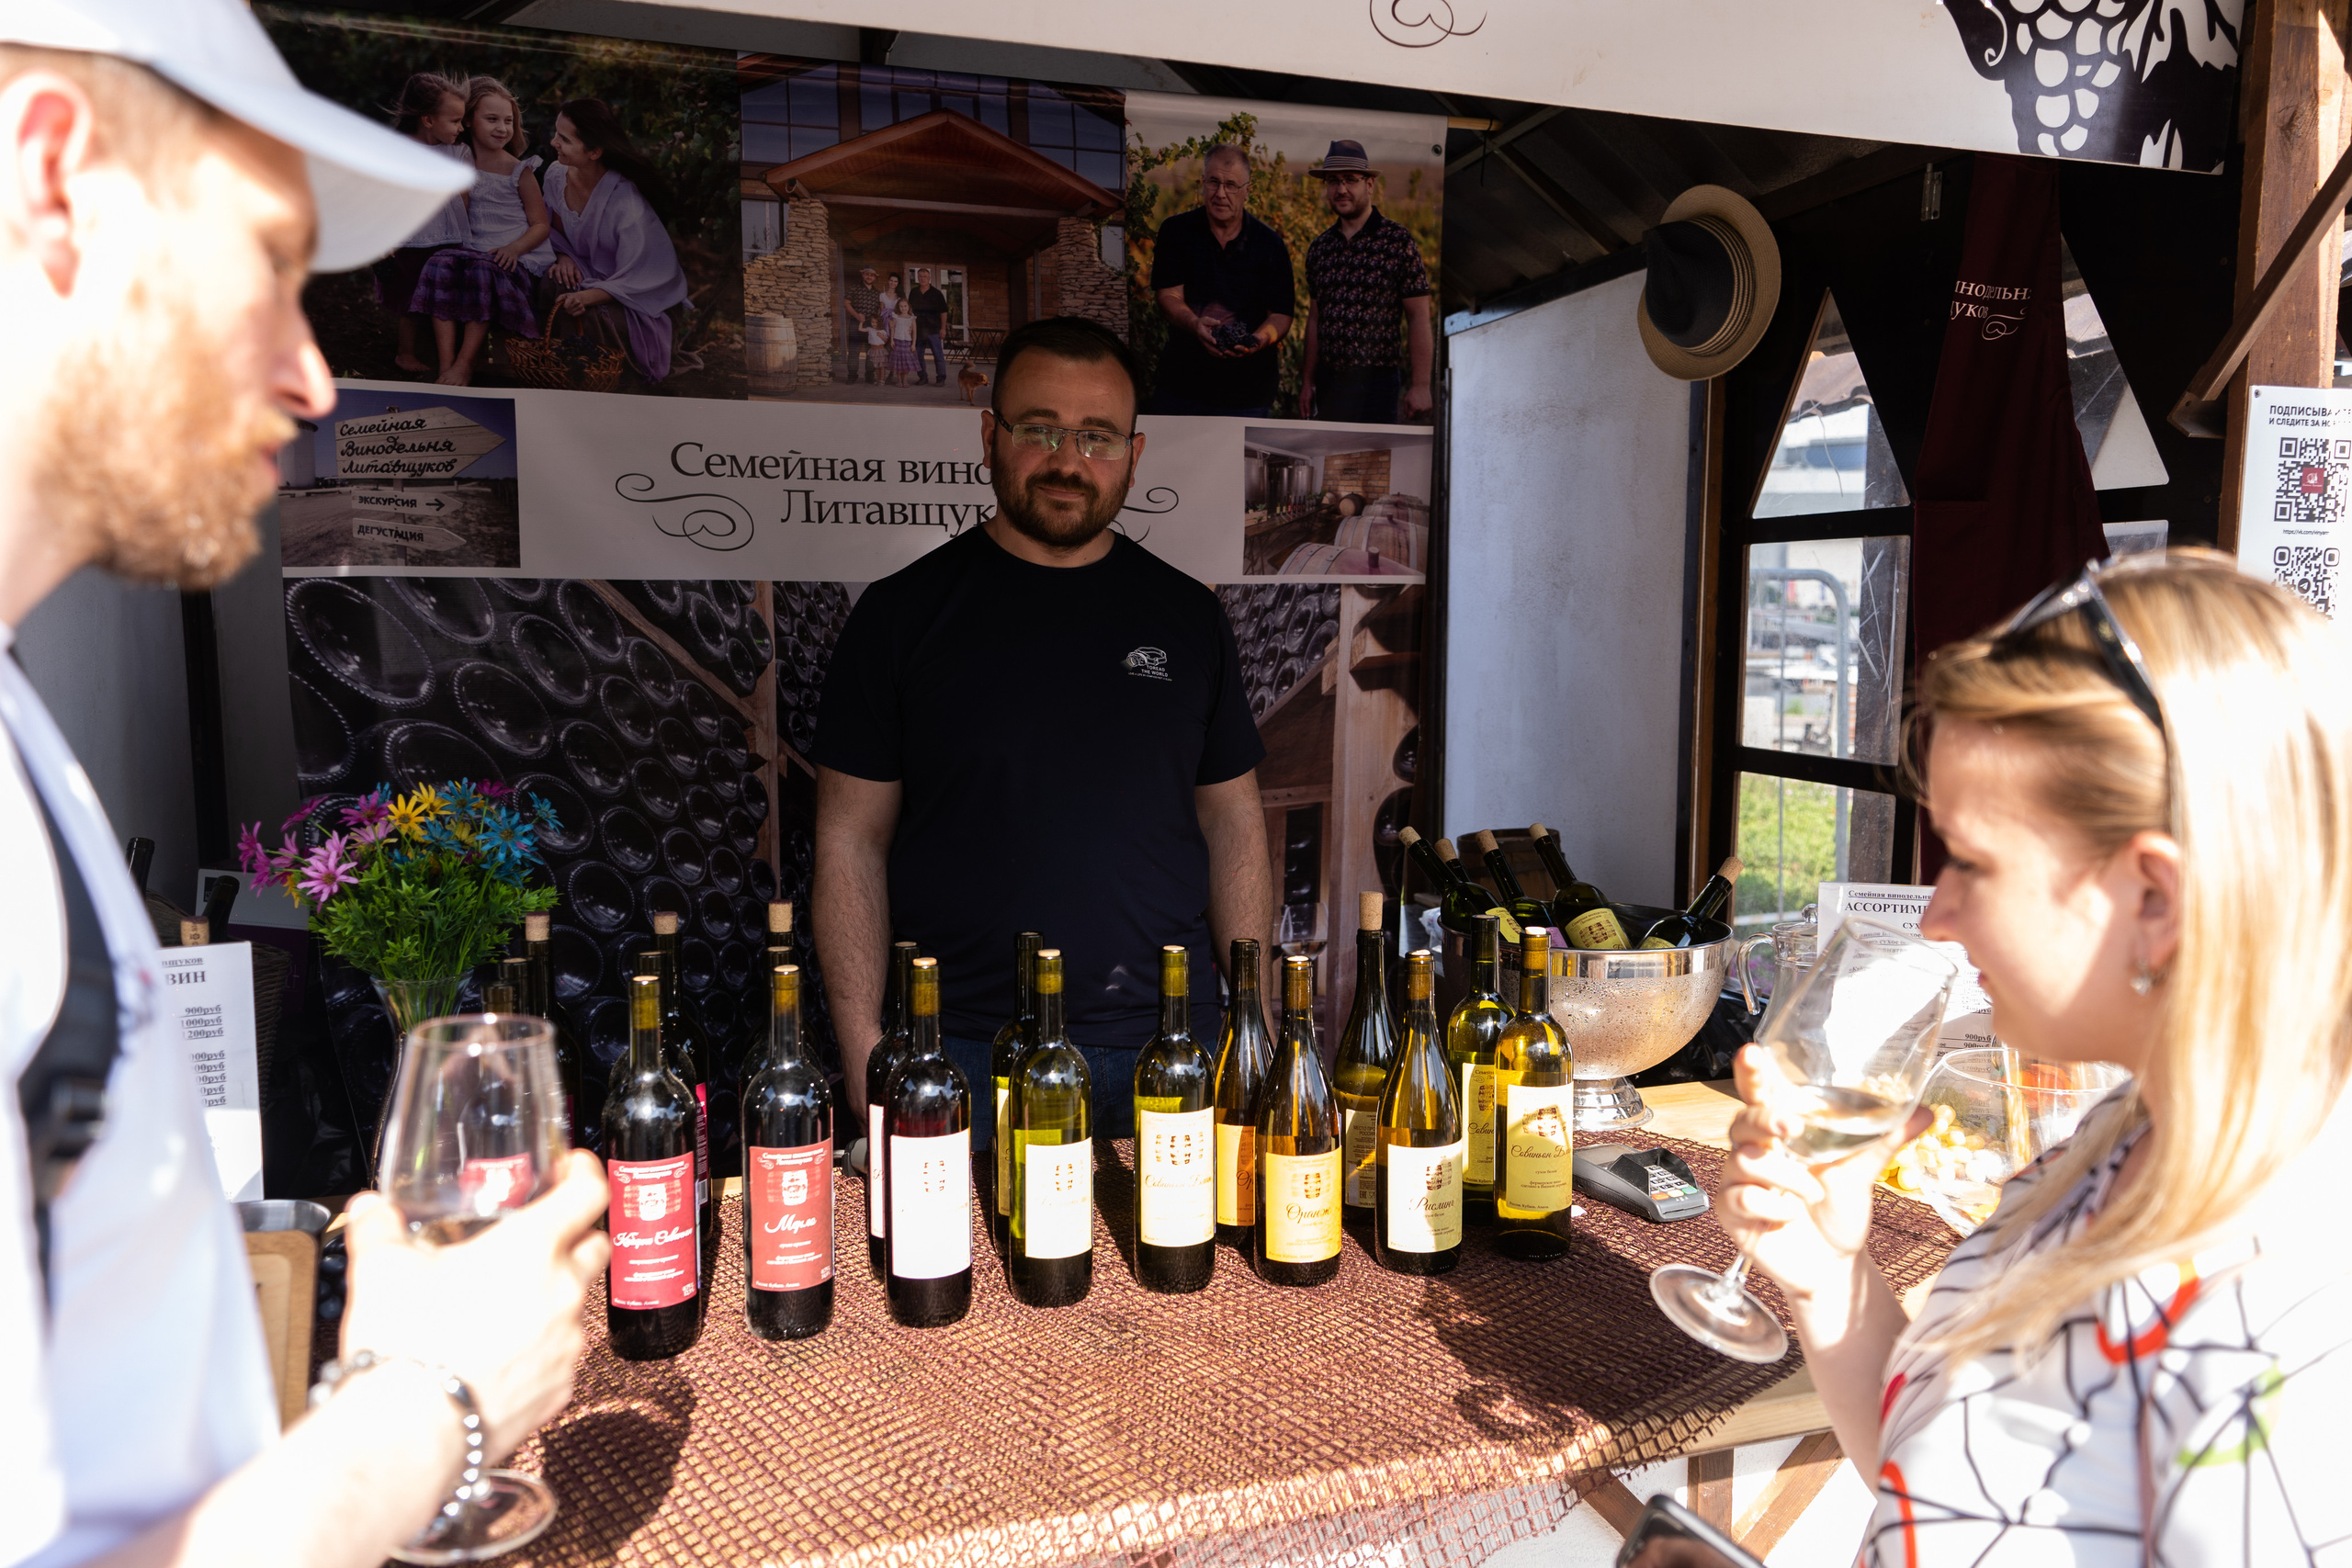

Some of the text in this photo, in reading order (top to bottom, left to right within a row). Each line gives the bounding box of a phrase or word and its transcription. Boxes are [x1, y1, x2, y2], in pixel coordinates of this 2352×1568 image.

[339, 416, 427, 436] Семейная
[2276, 418, 2309, 427] СЛЕДИТЕ
[2310, 419, 2320, 427] ЗА
[340, 435, 457, 457] Винодельня
[342, 458, 458, 478] Литавщуков
[670, 440, 995, 485] Семейная вино
[357, 495, 417, 508] ЭКСКУРСИЯ
[780, 488, 998, 538] Литавщук
[356, 525, 424, 542] ДЕГУСТАЦИЯ
[1848, 889, 1885, 898] Семейная
[1902, 921, 1921, 930] СУХ
[165, 970, 207, 986] ВИН
[185, 1004, 221, 1016] 900руб
[1964, 1033, 1992, 1043] 900руб
